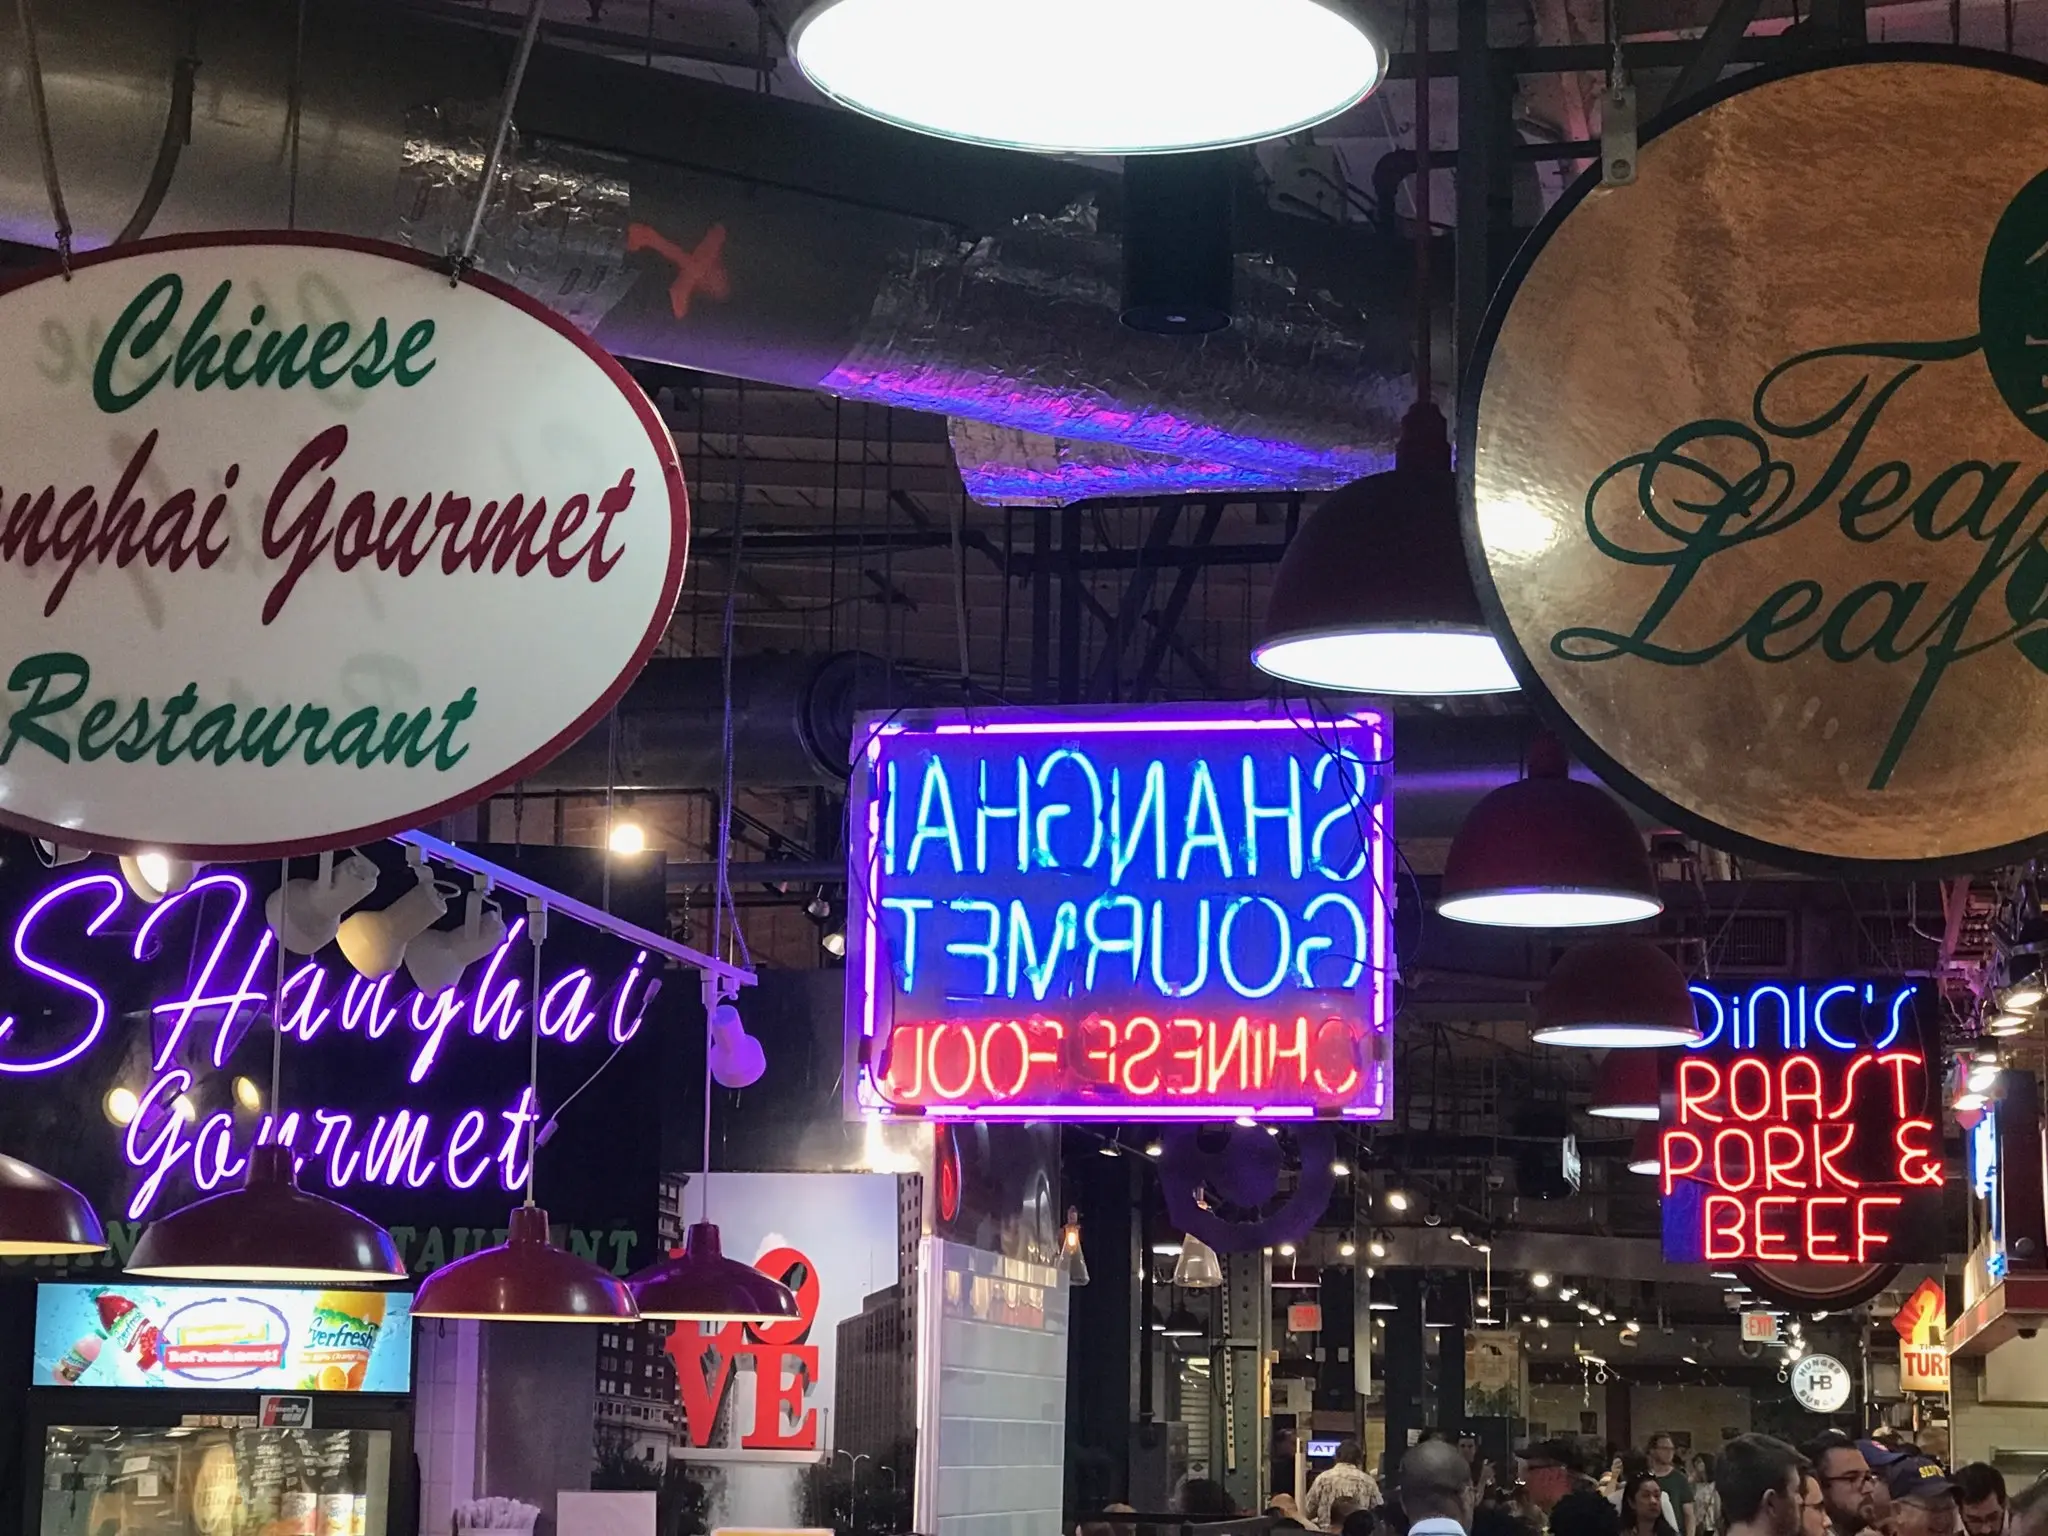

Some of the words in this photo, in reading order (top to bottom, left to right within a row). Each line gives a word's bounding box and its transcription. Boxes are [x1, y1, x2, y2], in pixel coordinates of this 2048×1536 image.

[93, 273, 437, 413] Chinese
[0, 428, 240, 617] nghai
[262, 424, 635, 625] Gourmet
[1550, 418, 2048, 789] Leaf
[0, 652, 477, 771] Restaurant
[1679, 1053, 1922, 1125] ROAST
[1663, 1124, 1860, 1197] PORK
[1895, 1120, 1945, 1187] &
[1704, 1194, 1902, 1264] BEEF
[1809, 1375, 1832, 1391] HB
[1313, 1445, 1337, 1453] AT
